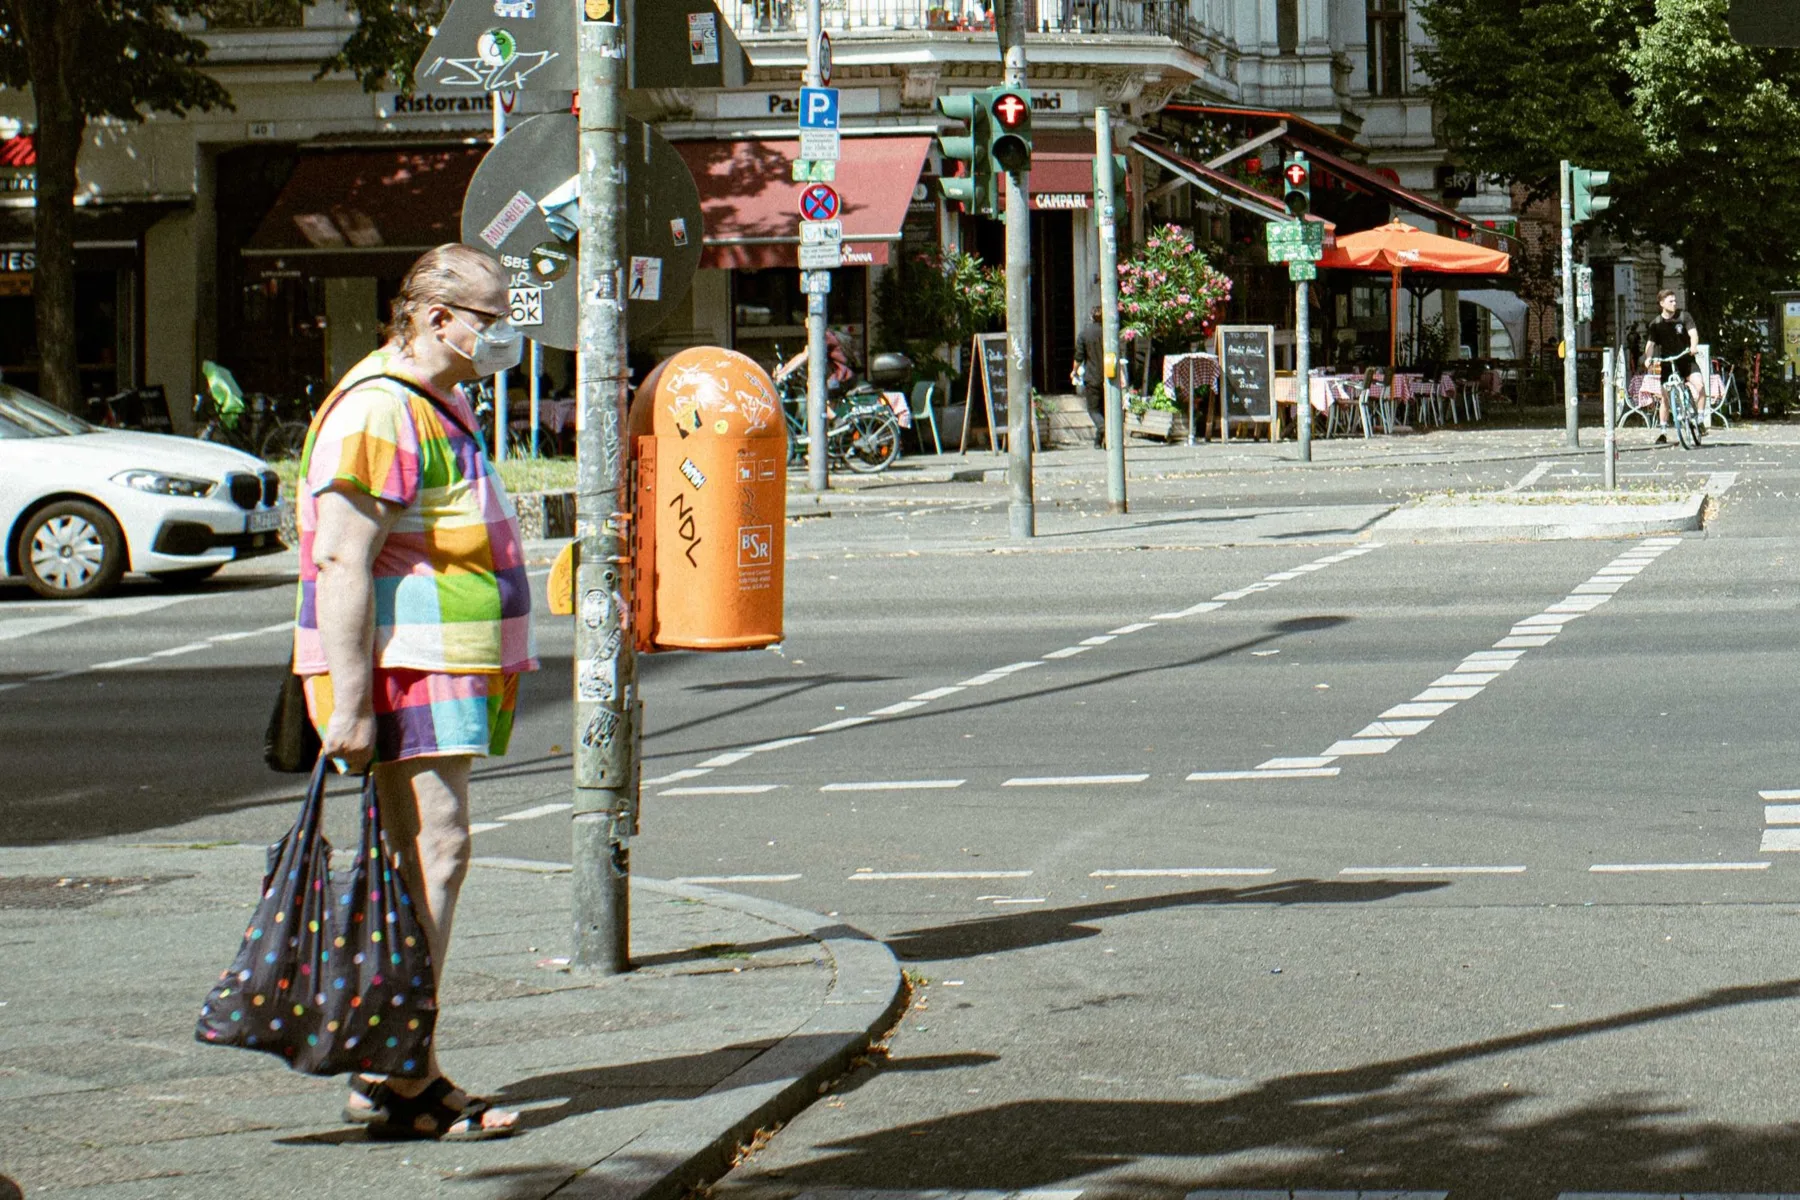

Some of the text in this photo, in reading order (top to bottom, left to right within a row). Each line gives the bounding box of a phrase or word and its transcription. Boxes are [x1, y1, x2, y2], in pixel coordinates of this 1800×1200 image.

[394, 93, 494, 112] Ristorant
[808, 92, 831, 124] P
[1444, 174, 1472, 191] sky
[511, 291, 539, 305] AM
[511, 307, 538, 322] OK
[741, 533, 768, 559] BSR
